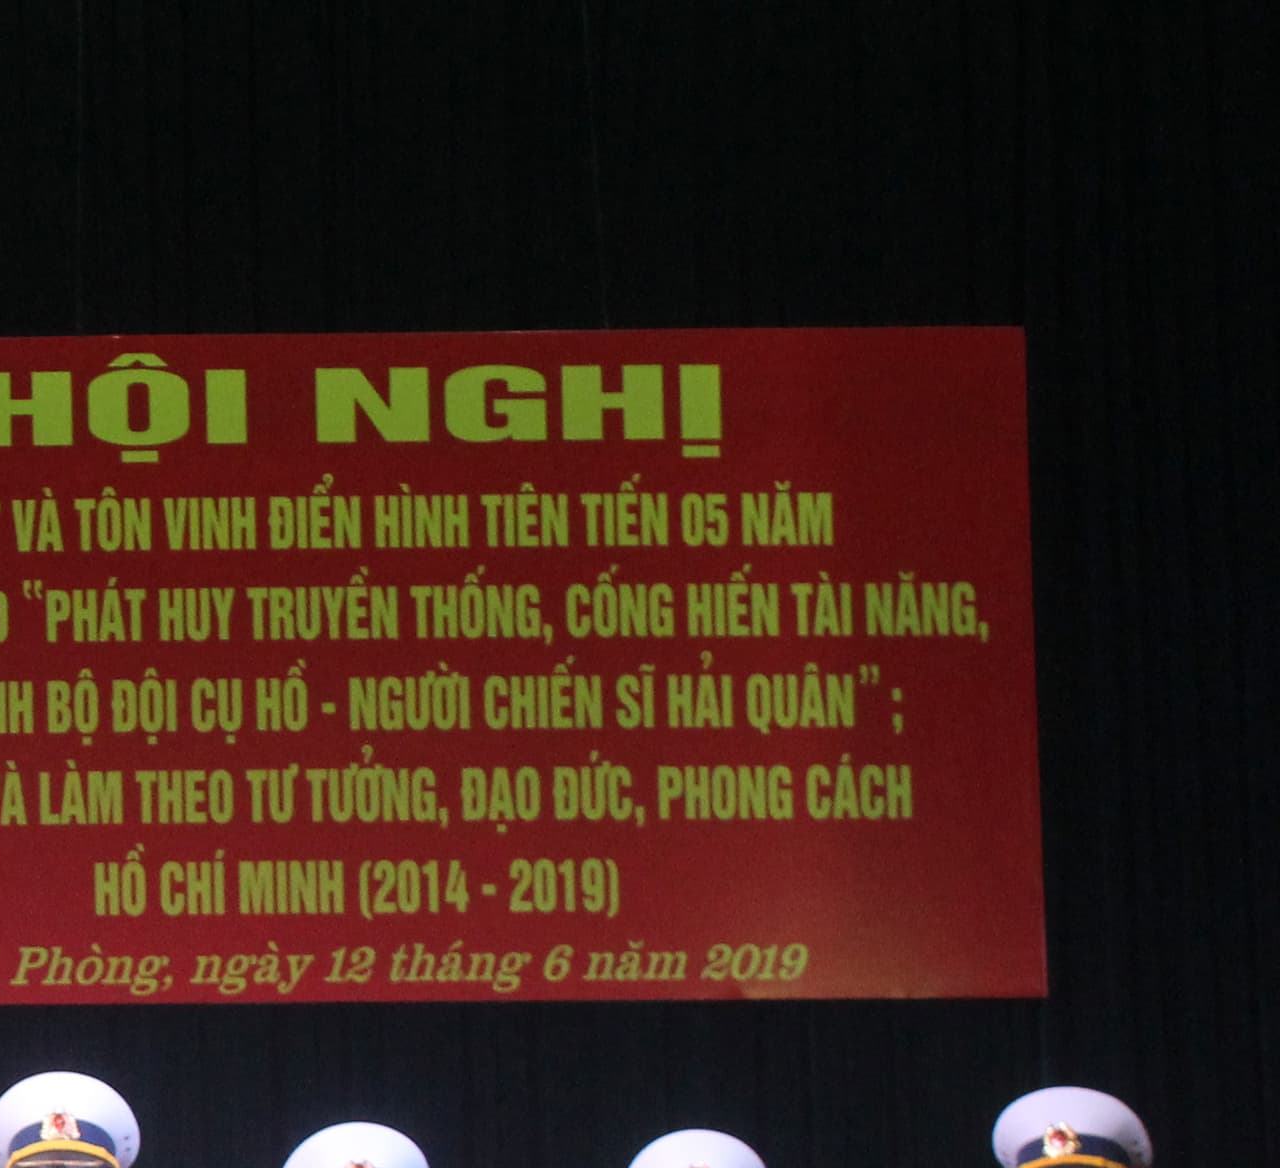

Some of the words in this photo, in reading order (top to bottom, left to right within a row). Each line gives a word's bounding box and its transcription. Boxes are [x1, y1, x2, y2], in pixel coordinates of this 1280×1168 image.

[315, 364, 722, 458] NGHỊ
[12, 488, 64, 552] VÀ
[74, 487, 152, 552] TÔN
[163, 497, 256, 550] VINH
[268, 474, 361, 550] ĐIỂN
[375, 484, 469, 548] HÌNH
[480, 483, 569, 547] TIÊN
[580, 474, 669, 547] TIẾN
[681, 493, 729, 546] 05
[741, 482, 833, 546] NĂM
[159, 588, 235, 641] HUY
[246, 567, 399, 640] TRUYỀN
[410, 566, 553, 644] THỐNG,
[566, 565, 674, 638] CỐNG
[687, 564, 780, 637] HIẾN
[791, 572, 852, 636] TÀI
[865, 572, 988, 641] NĂNG,
[47, 669, 99, 745] BỘ
[112, 668, 177, 745] ĐỘI
[191, 678, 243, 744] CỤ
[256, 659, 308, 731] HỒ
[322, 702, 336, 714] -
[349, 662, 470, 730] NGƯỜI
[484, 656, 603, 730] CHIẾN
[616, 664, 655, 729] SĨ
[668, 651, 733, 728] HẢI
[892, 688, 903, 733] ;
[39, 760, 123, 825] LÀM
[135, 770, 233, 824] THEO
[246, 763, 299, 823] TƯ
[306, 745, 448, 827] TƯỞNG,
[461, 766, 541, 832] ĐẠO
[553, 751, 645, 825] ĐỨC,
[658, 765, 793, 820] PHONG
[806, 754, 912, 819] CÁCH
[95, 844, 146, 916] HỒ
[160, 850, 225, 916] CHÍ
[239, 860, 344, 914] MINH
[359, 860, 469, 919] (2014
[482, 884, 496, 895] -
[510, 858, 619, 917] 2019)
[11, 944, 172, 995] Phòng,
[192, 943, 313, 994] ngày
[326, 947, 376, 983] 12
[390, 941, 531, 992] tháng
[544, 945, 573, 981] 6
[584, 942, 687, 980] năm
[702, 944, 809, 982] 2019
